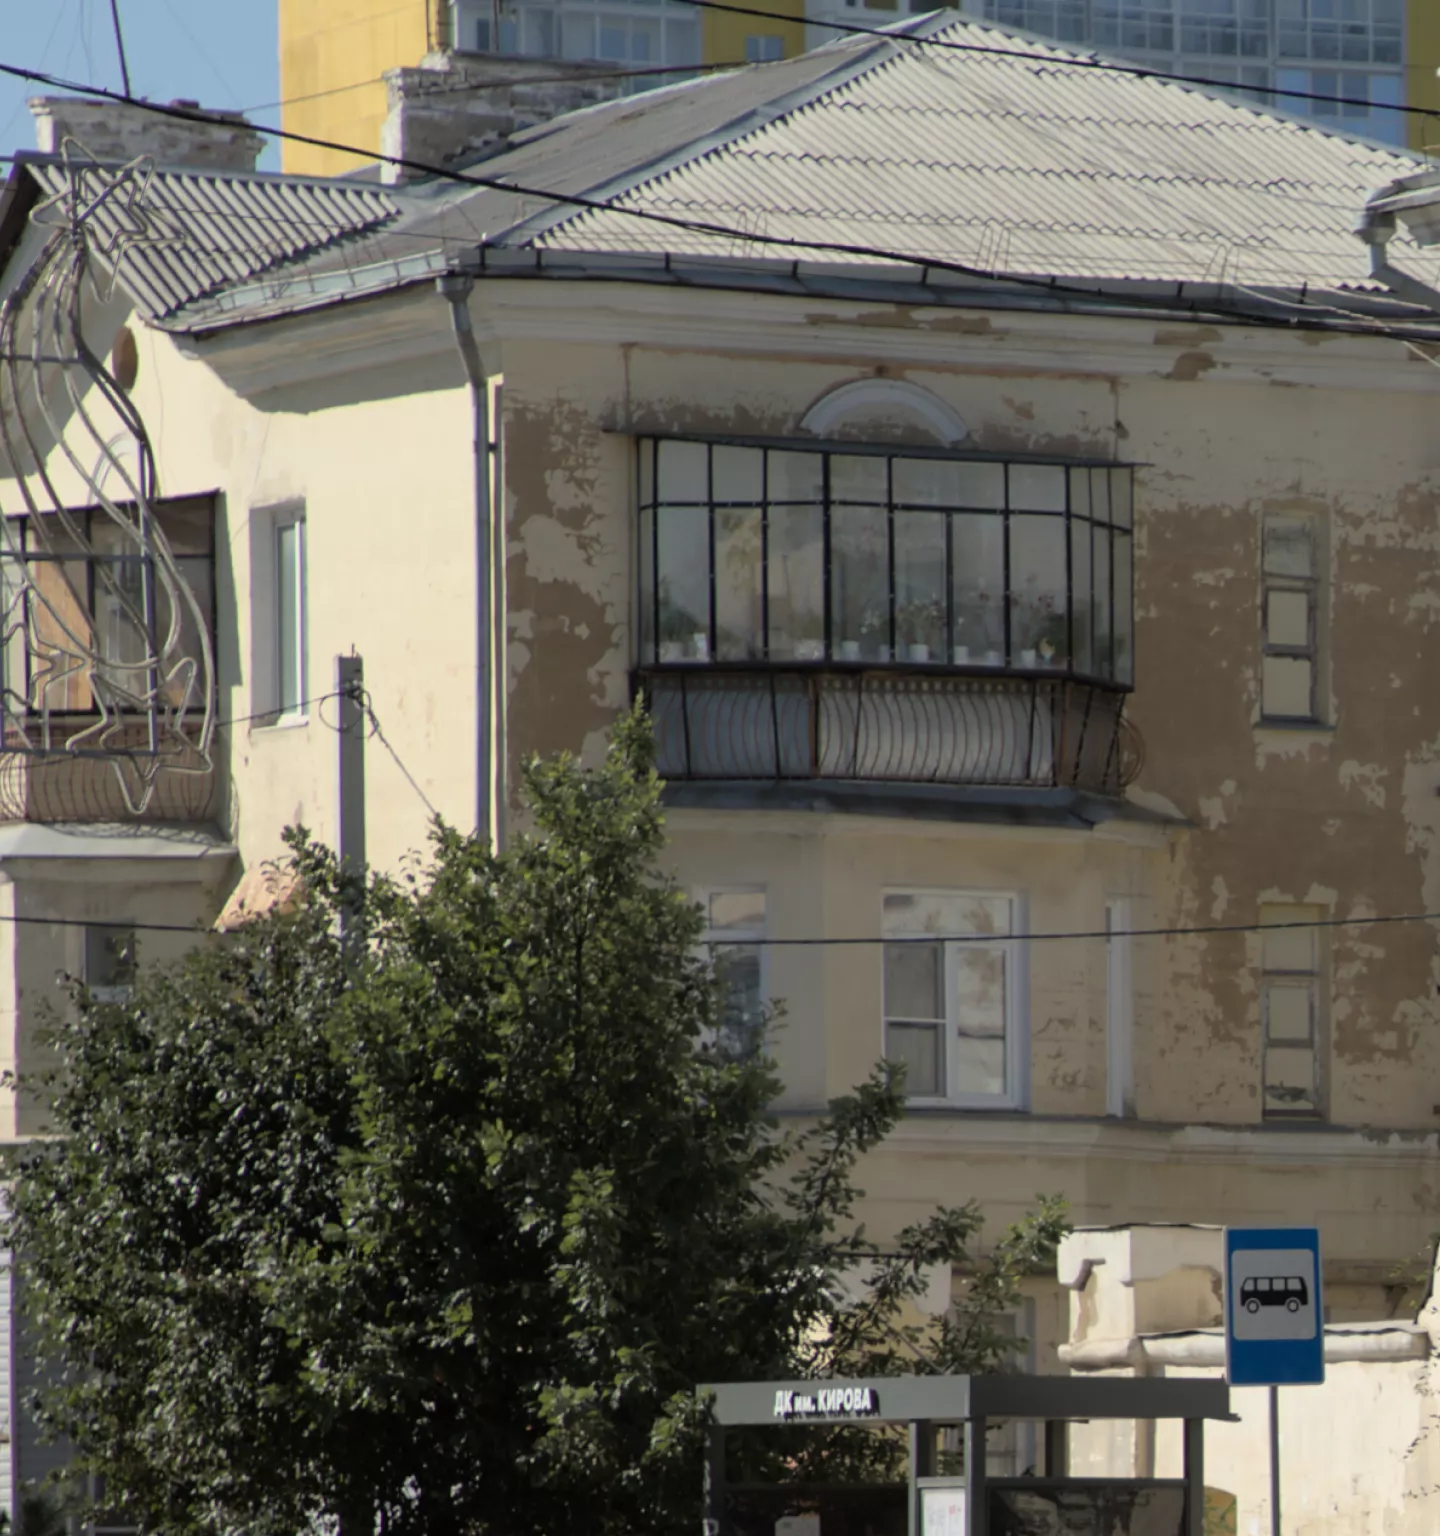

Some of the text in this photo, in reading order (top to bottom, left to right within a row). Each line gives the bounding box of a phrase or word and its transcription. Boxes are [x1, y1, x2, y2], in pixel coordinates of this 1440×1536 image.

[773, 1387, 872, 1416] ДК им. КИРОВА
